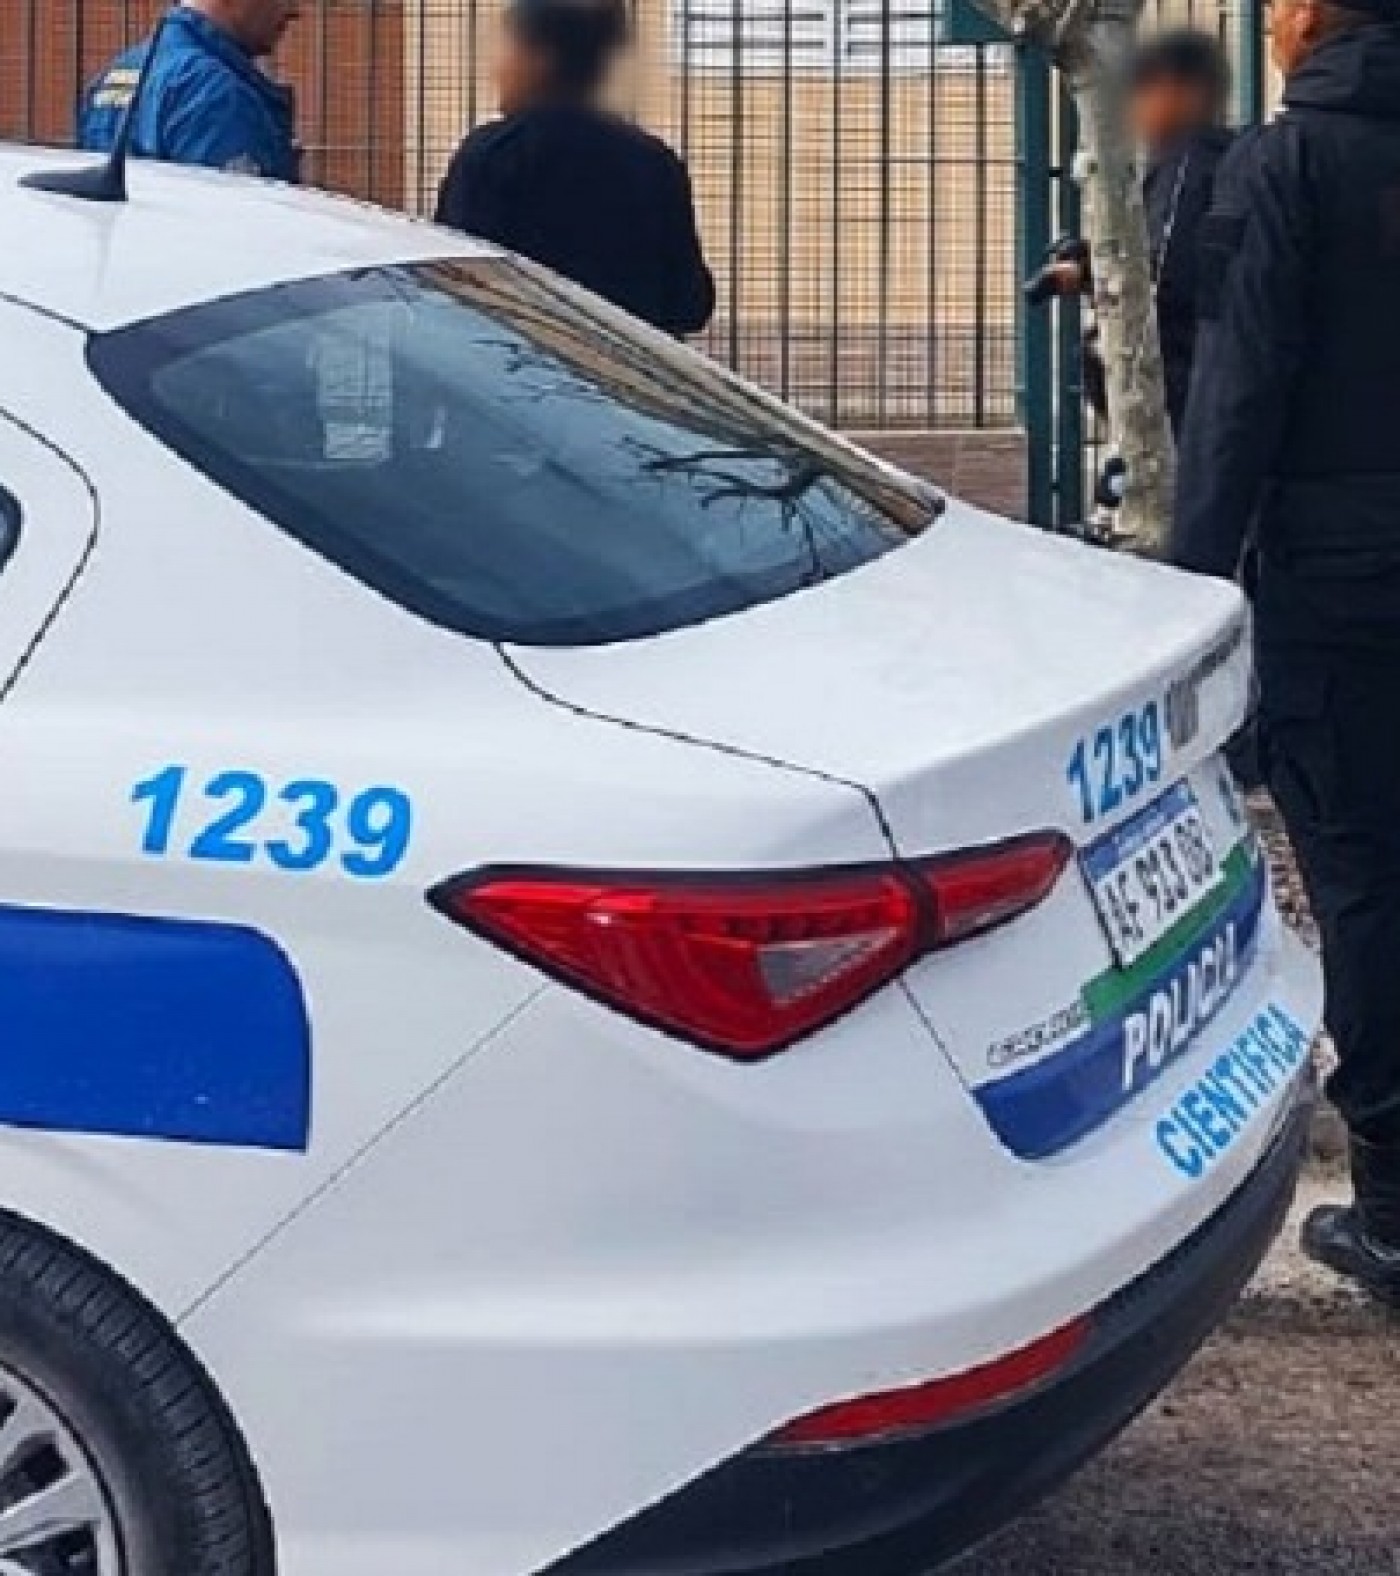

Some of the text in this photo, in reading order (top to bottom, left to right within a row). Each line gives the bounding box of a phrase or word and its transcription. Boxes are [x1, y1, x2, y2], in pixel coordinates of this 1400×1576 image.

[130, 764, 412, 878] 1239
[1066, 699, 1161, 823] 1239
[1155, 1000, 1307, 1178] CIENTIFICA
